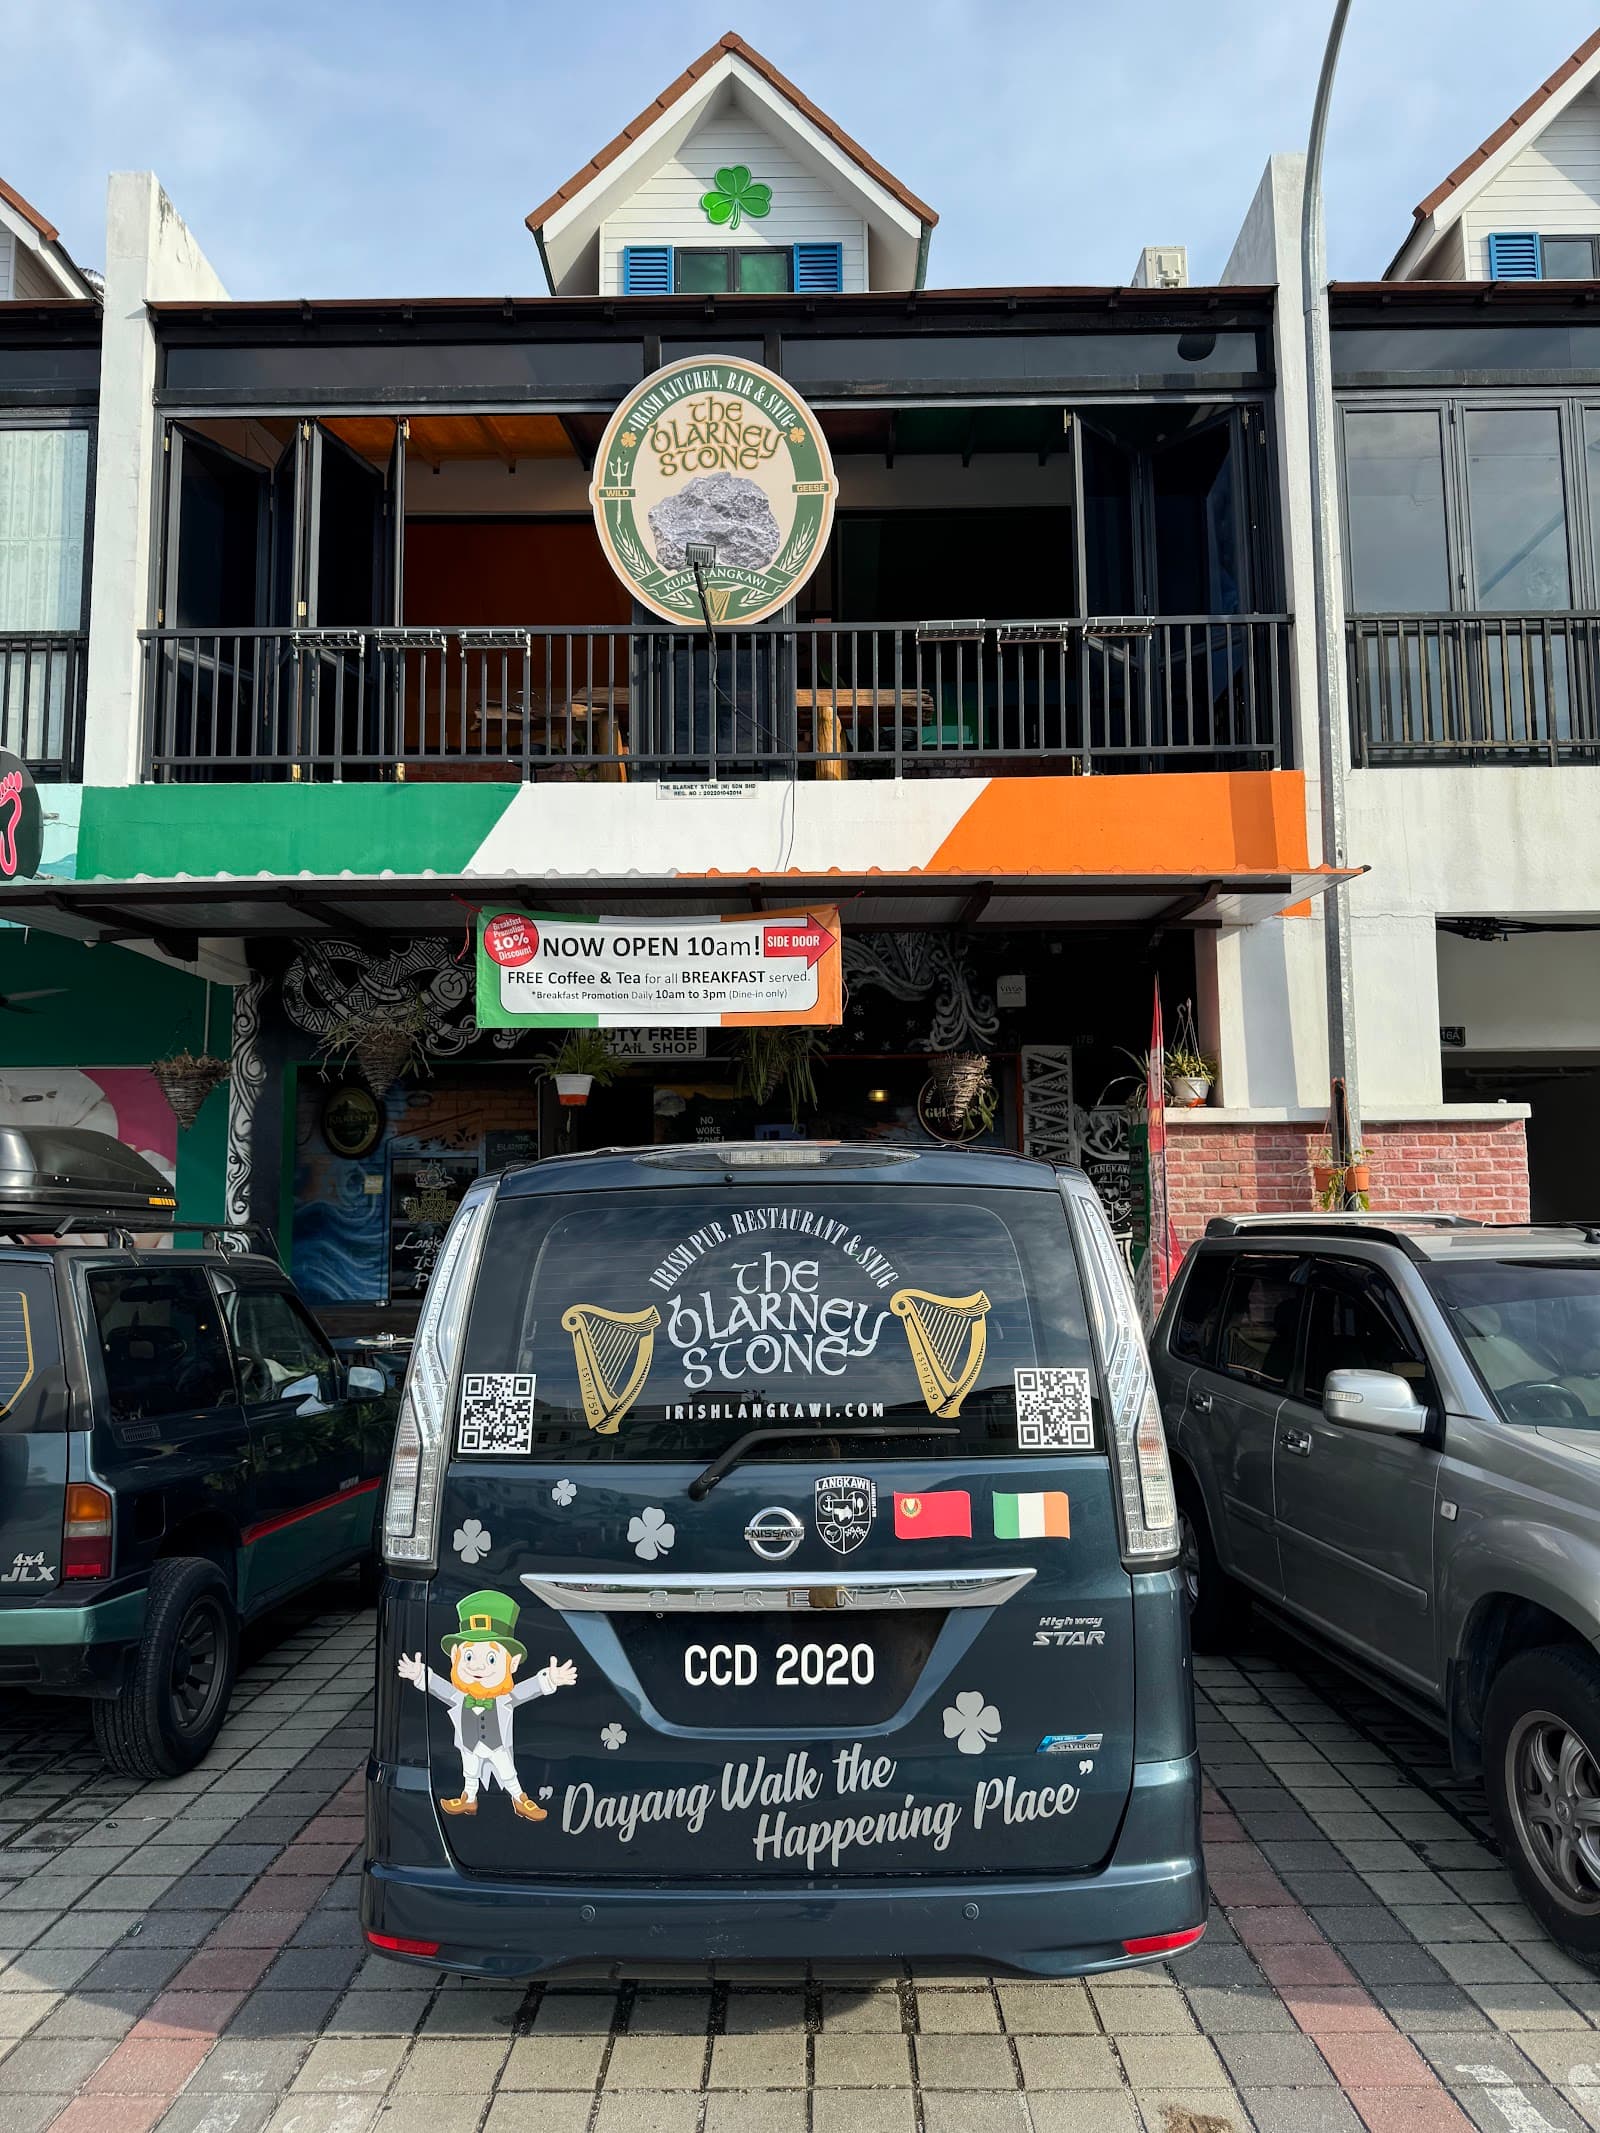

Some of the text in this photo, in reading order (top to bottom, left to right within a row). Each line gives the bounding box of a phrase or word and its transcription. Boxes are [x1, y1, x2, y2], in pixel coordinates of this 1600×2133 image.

[628, 369, 797, 430] IRISH KITCHEN, BAR & SNUG
[660, 445, 760, 477] STONE
[796, 484, 825, 492] GEESE
[663, 568, 768, 592] KUAH LANGKAWI
[493, 917, 522, 931] Breakfast
[493, 925, 525, 938] Promotion
[493, 933, 530, 952] 10%
[544, 936, 760, 957] NOW OPEN 10am!
[767, 935, 820, 948] SIDE DOOR
[498, 946, 532, 961] Discount
[508, 970, 811, 984] FREE Coffee & Tea for all BREAKFAST served.
[581, 991, 629, 1000] Promotion
[631, 991, 653, 1001] Daily
[655, 990, 685, 999] 10am
[688, 990, 700, 999] to
[702, 989, 726, 1001] 3pm
[729, 989, 764, 1000] (Dine-in
[766, 988, 788, 1000] only)
[648, 1028, 698, 1041] FREE
[603, 1042, 697, 1054] ETAIL SHOP
[700, 1115, 714, 1124] NO
[696, 1126, 721, 1136] WOKE
[648, 1207, 900, 1292] IRISH PUB. RESTAURANT & SNUG
[682, 1333, 849, 1389] STONE
[922, 1373, 939, 1401] 1759
[665, 1402, 884, 1420] IRISHLANGKAWI.COM
[816, 1478, 870, 1491] LANGKAWI
[750, 1528, 799, 1538] NISSAN
[13, 1551, 45, 1567] 4x4
[1, 1566, 56, 1582] JLX
[647, 1587, 907, 1608] SERENA
[1039, 1616, 1103, 1629] Highway
[1032, 1631, 1106, 1646] STAR
[684, 1642, 875, 1687] CCD 2020
[721, 1752, 824, 1811] Walk
[832, 1742, 897, 1796] the
[753, 1793, 961, 1870] Happening
